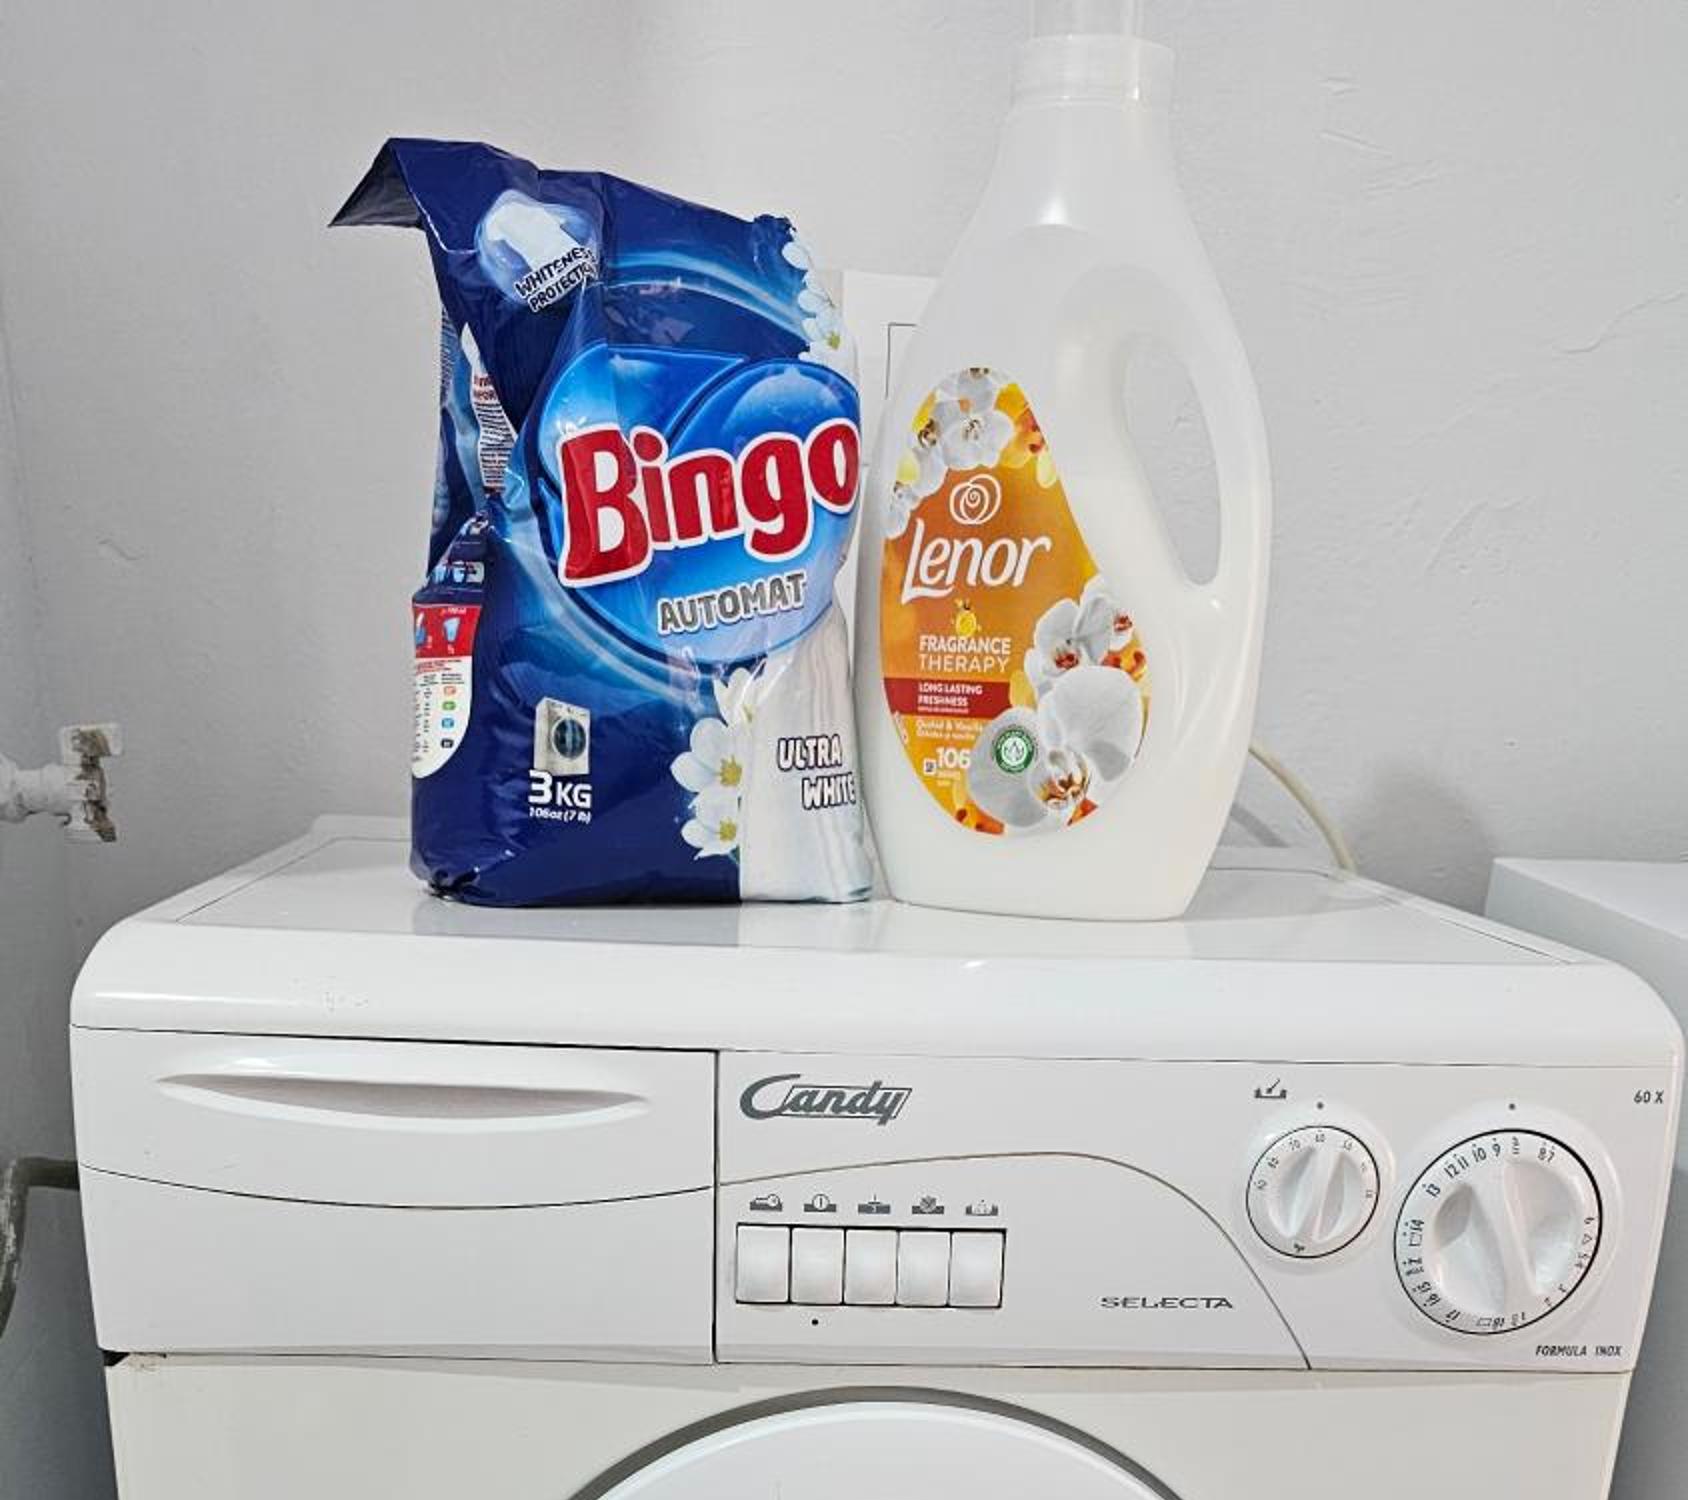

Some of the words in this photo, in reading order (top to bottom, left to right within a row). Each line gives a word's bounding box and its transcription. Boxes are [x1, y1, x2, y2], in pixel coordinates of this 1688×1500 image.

[558, 419, 861, 587] Bingo
[901, 517, 1052, 605] Lenor
[658, 571, 806, 633] AUTOMAT
[919, 635, 1012, 655] FRAGRANCE
[919, 653, 1010, 673] THERAPY
[918, 682, 942, 693] LONG
[945, 683, 983, 695] LASTING
[917, 694, 969, 707] FRESHNESS
[777, 733, 842, 771] ULTRA
[936, 747, 971, 769] 106
[528, 769, 553, 804] 3
[556, 782, 592, 808] KG
[740, 1073, 912, 1126] Candy
[1633, 1089, 1651, 1104] 60
[1655, 1089, 1665, 1104] X
[1472, 1147, 1487, 1163] 10
[1492, 1143, 1501, 1158] 9
[1444, 1163, 1460, 1179] 12
[1457, 1156, 1469, 1170] 11
[1425, 1183, 1441, 1198] 13
[1410, 1219, 1425, 1232] 14
[1100, 1296, 1234, 1309] SELECTA
[1426, 1293, 1441, 1307] 16
[1534, 1344, 1588, 1357] FORMULA
[1595, 1345, 1622, 1357] INOX
